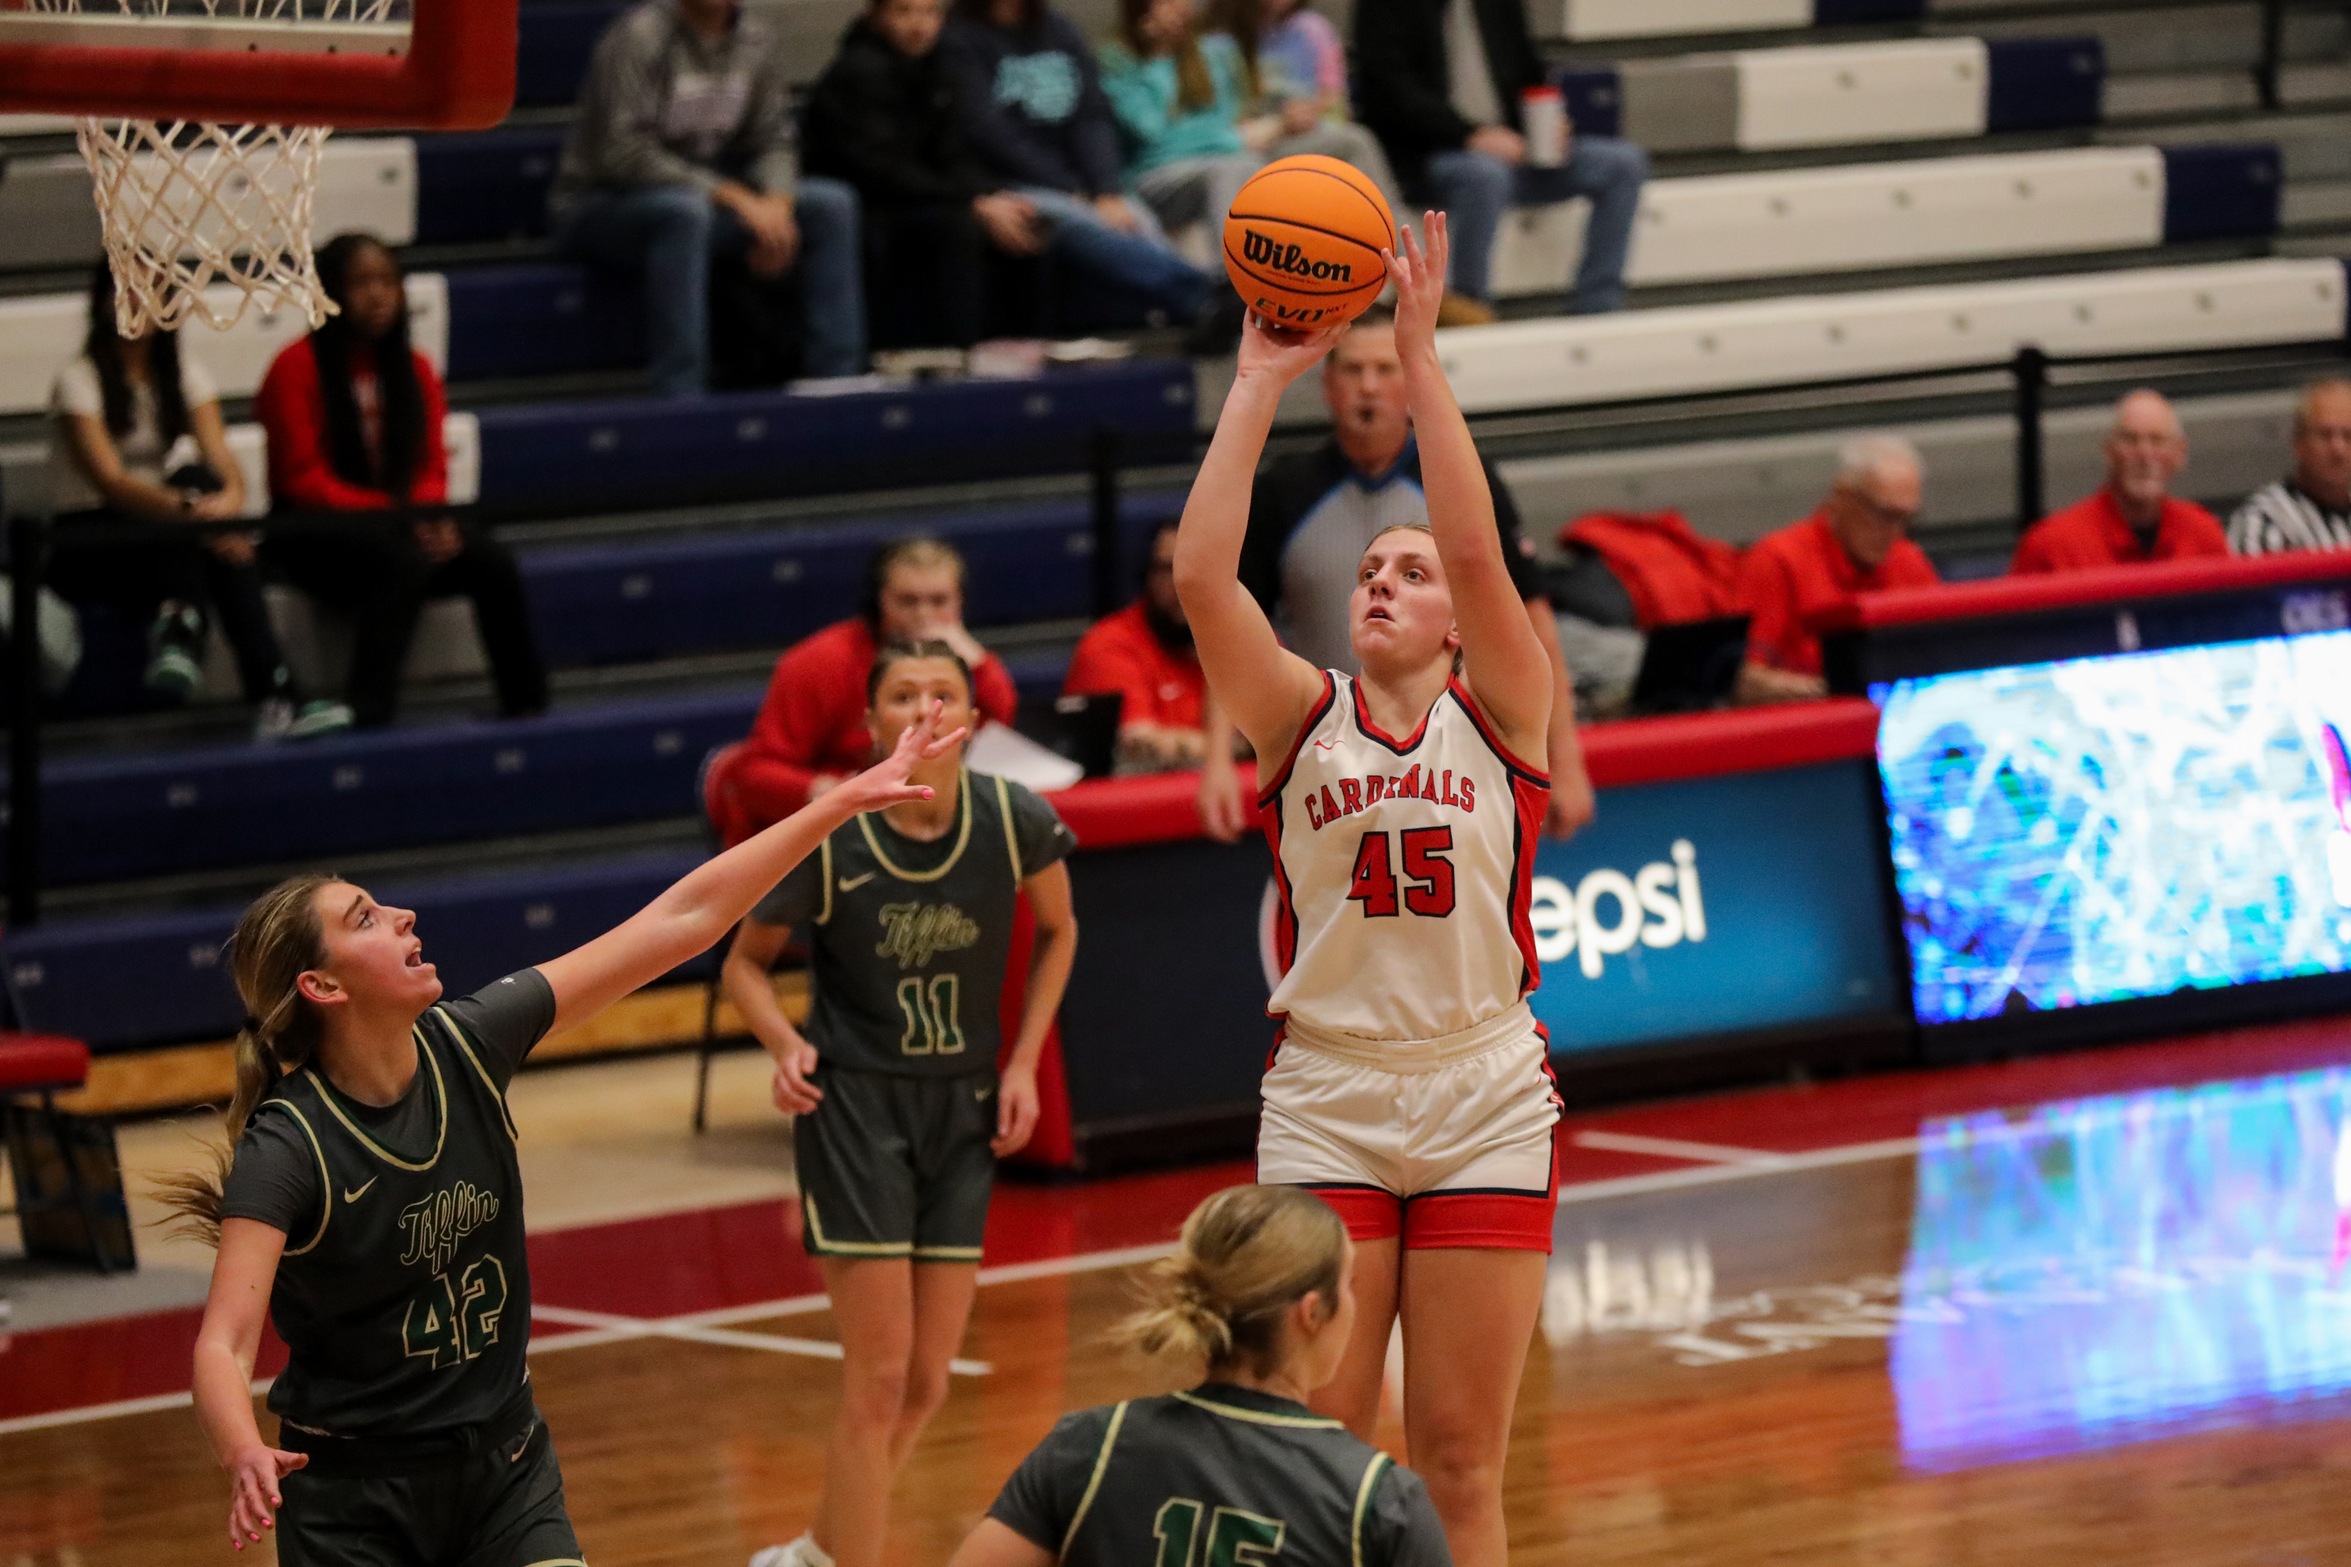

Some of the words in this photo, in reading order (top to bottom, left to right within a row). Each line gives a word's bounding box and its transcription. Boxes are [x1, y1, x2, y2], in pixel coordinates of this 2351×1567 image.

[1243, 228, 1351, 283] Wilson
[1305, 763, 1475, 831] CARDINALS
[1346, 825, 1456, 918] 45
[1528, 838, 1707, 980] epsi
[876, 901, 981, 969] Tiffin
[897, 973, 966, 1056] 11
[398, 1180, 499, 1275] Tiffin
[402, 1253, 508, 1371] 42
